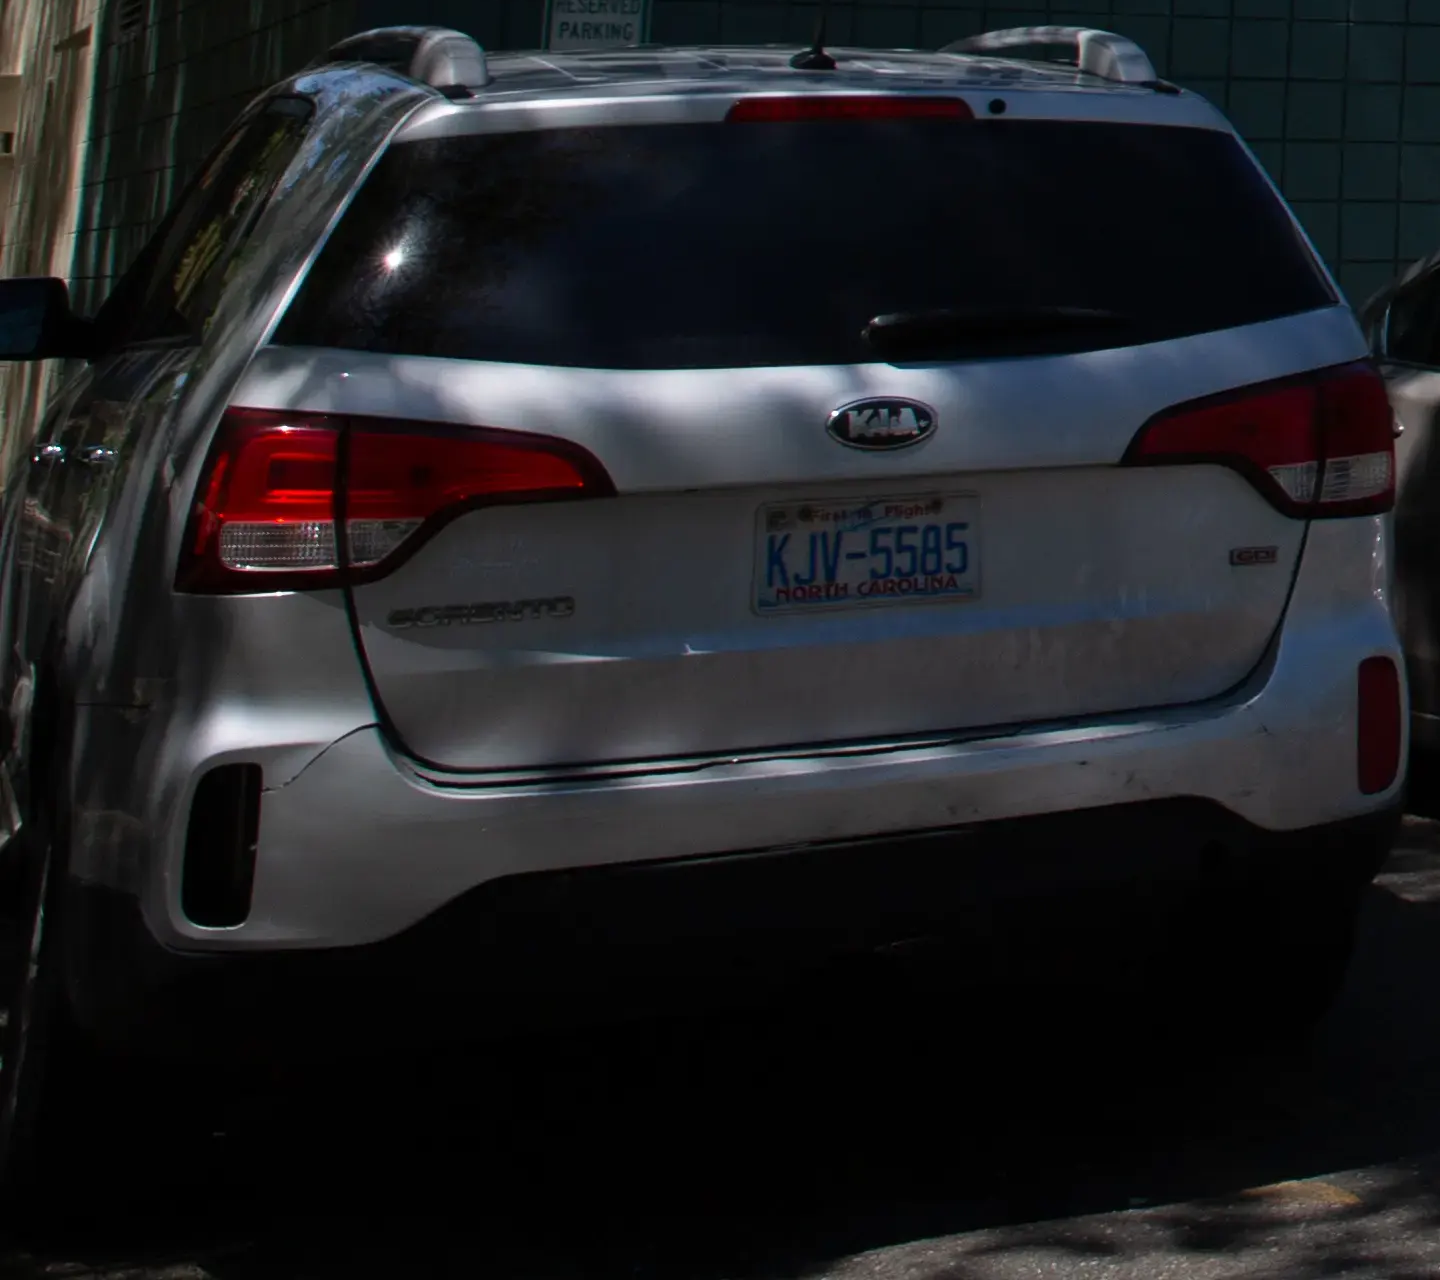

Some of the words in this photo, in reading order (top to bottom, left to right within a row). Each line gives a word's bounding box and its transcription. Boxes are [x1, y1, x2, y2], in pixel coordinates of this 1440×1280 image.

[559, 22, 634, 41] PARKING
[846, 407, 919, 438] KIA
[810, 509, 847, 523] First
[766, 522, 970, 588] KJV-5585
[776, 582, 848, 603] NORTH
[857, 575, 959, 597] CAROLINA
